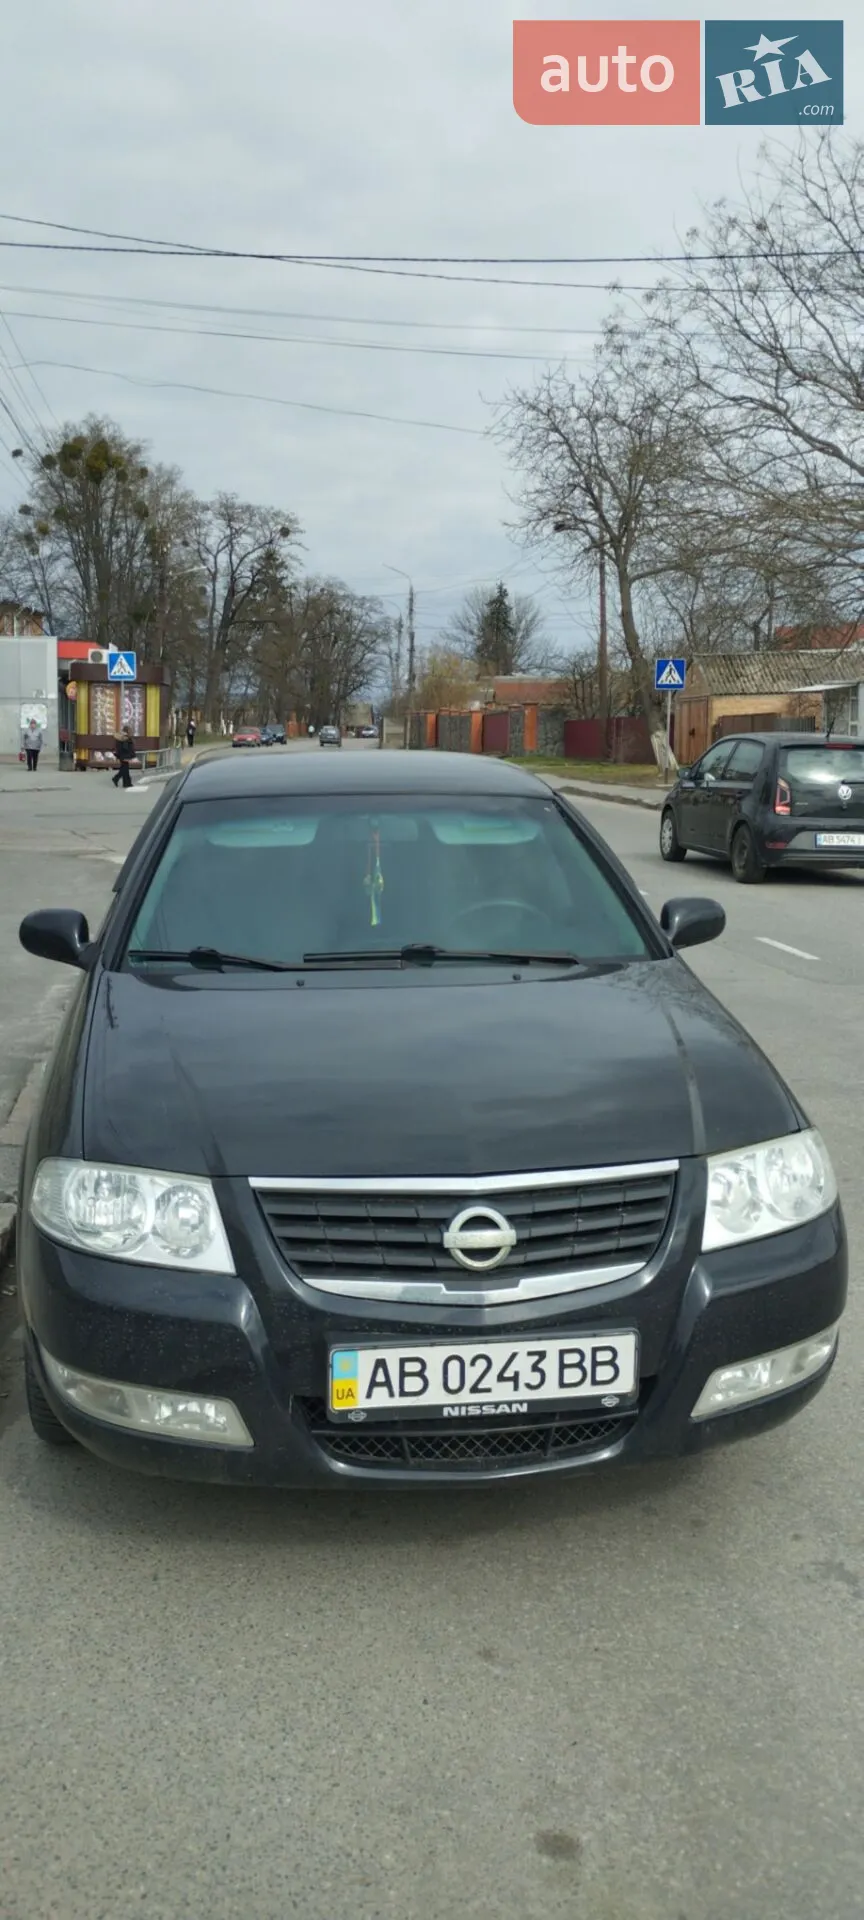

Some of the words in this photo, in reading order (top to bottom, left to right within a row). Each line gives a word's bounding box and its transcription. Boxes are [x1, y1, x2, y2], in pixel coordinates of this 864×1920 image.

[365, 1358, 430, 1400] AB
[442, 1350, 547, 1395] 0243
[558, 1345, 621, 1389] BB
[336, 1388, 355, 1401] UA
[442, 1401, 529, 1418] NISSAN
